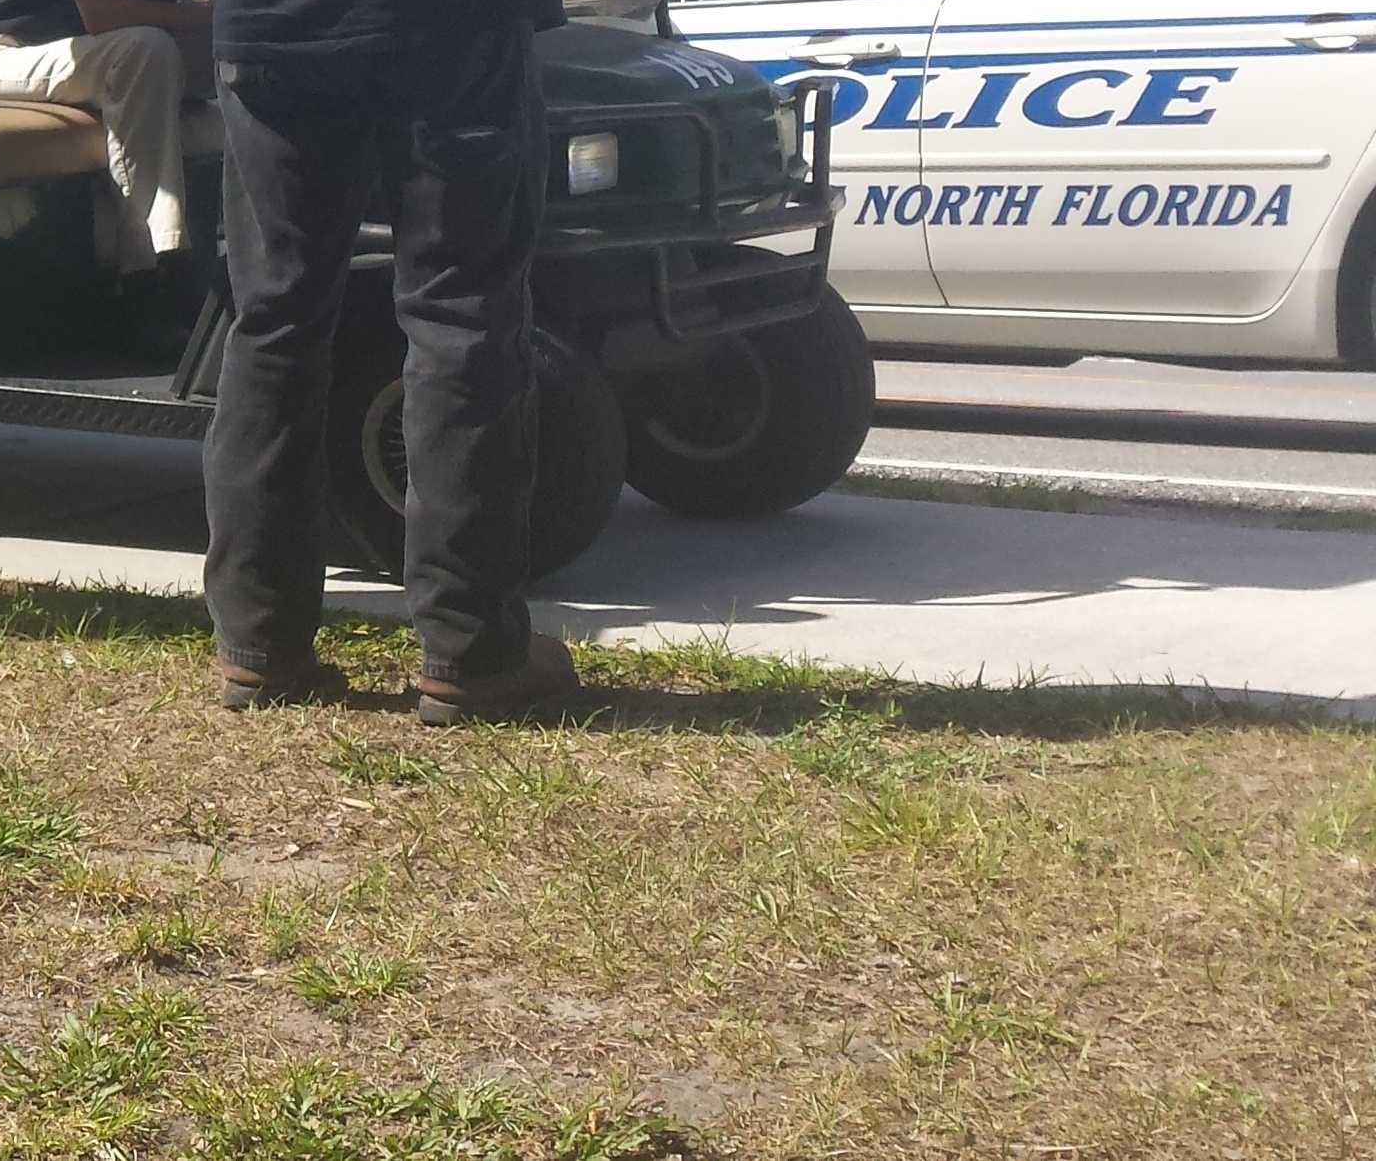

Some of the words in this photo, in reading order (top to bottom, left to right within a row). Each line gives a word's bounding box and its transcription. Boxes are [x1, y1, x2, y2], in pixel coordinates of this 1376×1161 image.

[781, 67, 1240, 129] OLICE
[854, 184, 1043, 226] NORTH
[1052, 183, 1292, 227] FLORIDA
